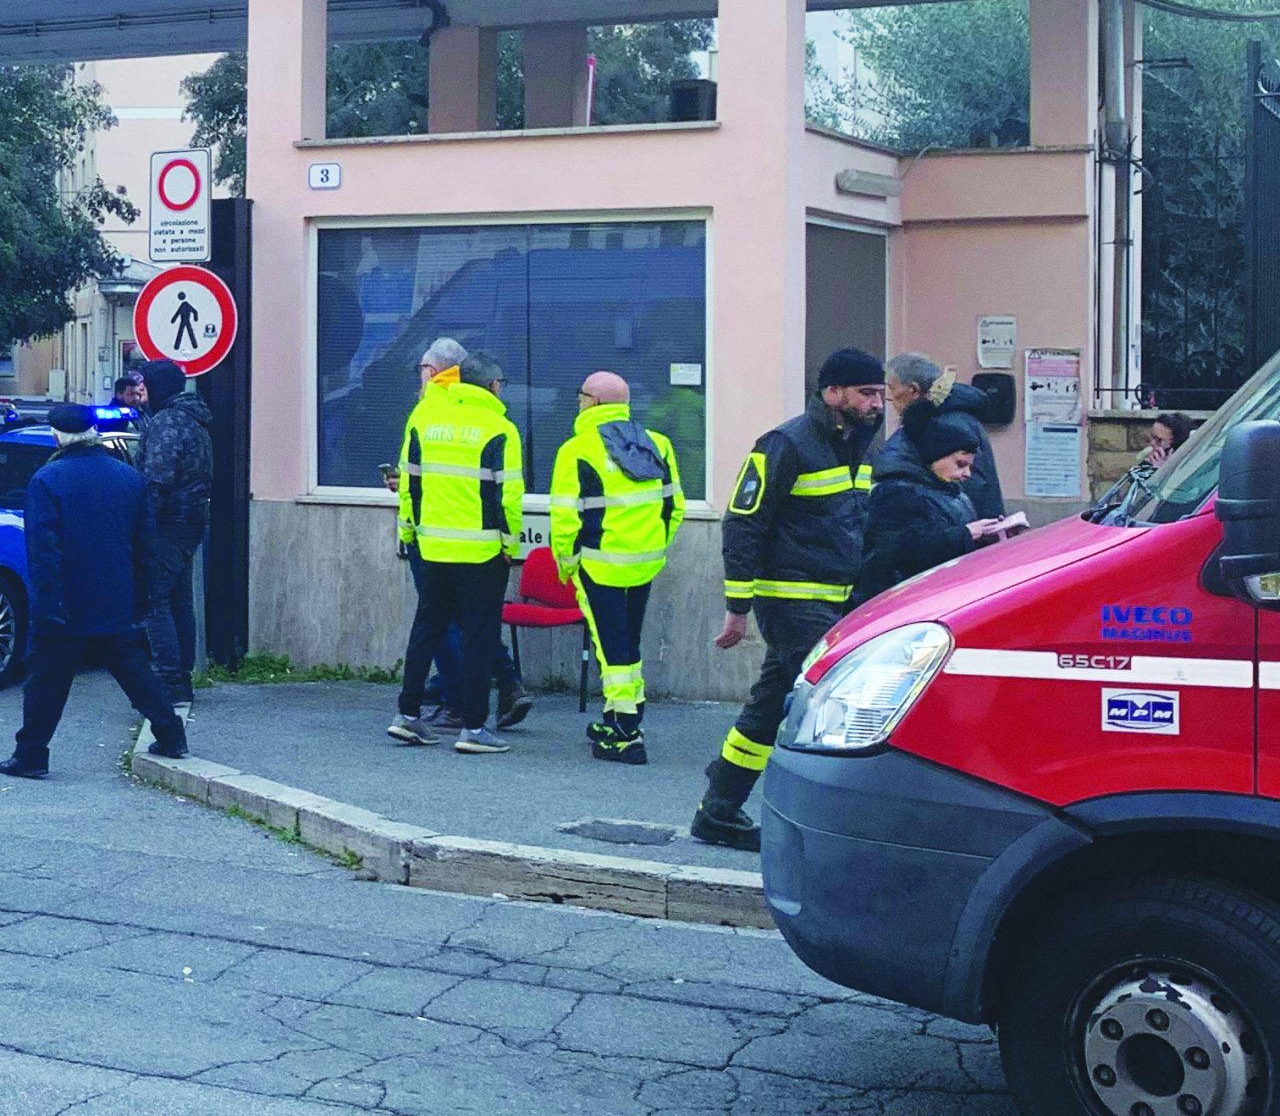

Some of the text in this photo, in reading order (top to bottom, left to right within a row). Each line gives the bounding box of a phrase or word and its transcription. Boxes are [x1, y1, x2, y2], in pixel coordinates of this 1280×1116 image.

[320, 168, 330, 184] 3
[160, 219, 198, 227] circolazione
[519, 527, 543, 544] ale
[1102, 605, 1193, 625] IVECO
[1058, 653, 1131, 670] 65C17
[1108, 707, 1173, 720] MPM
